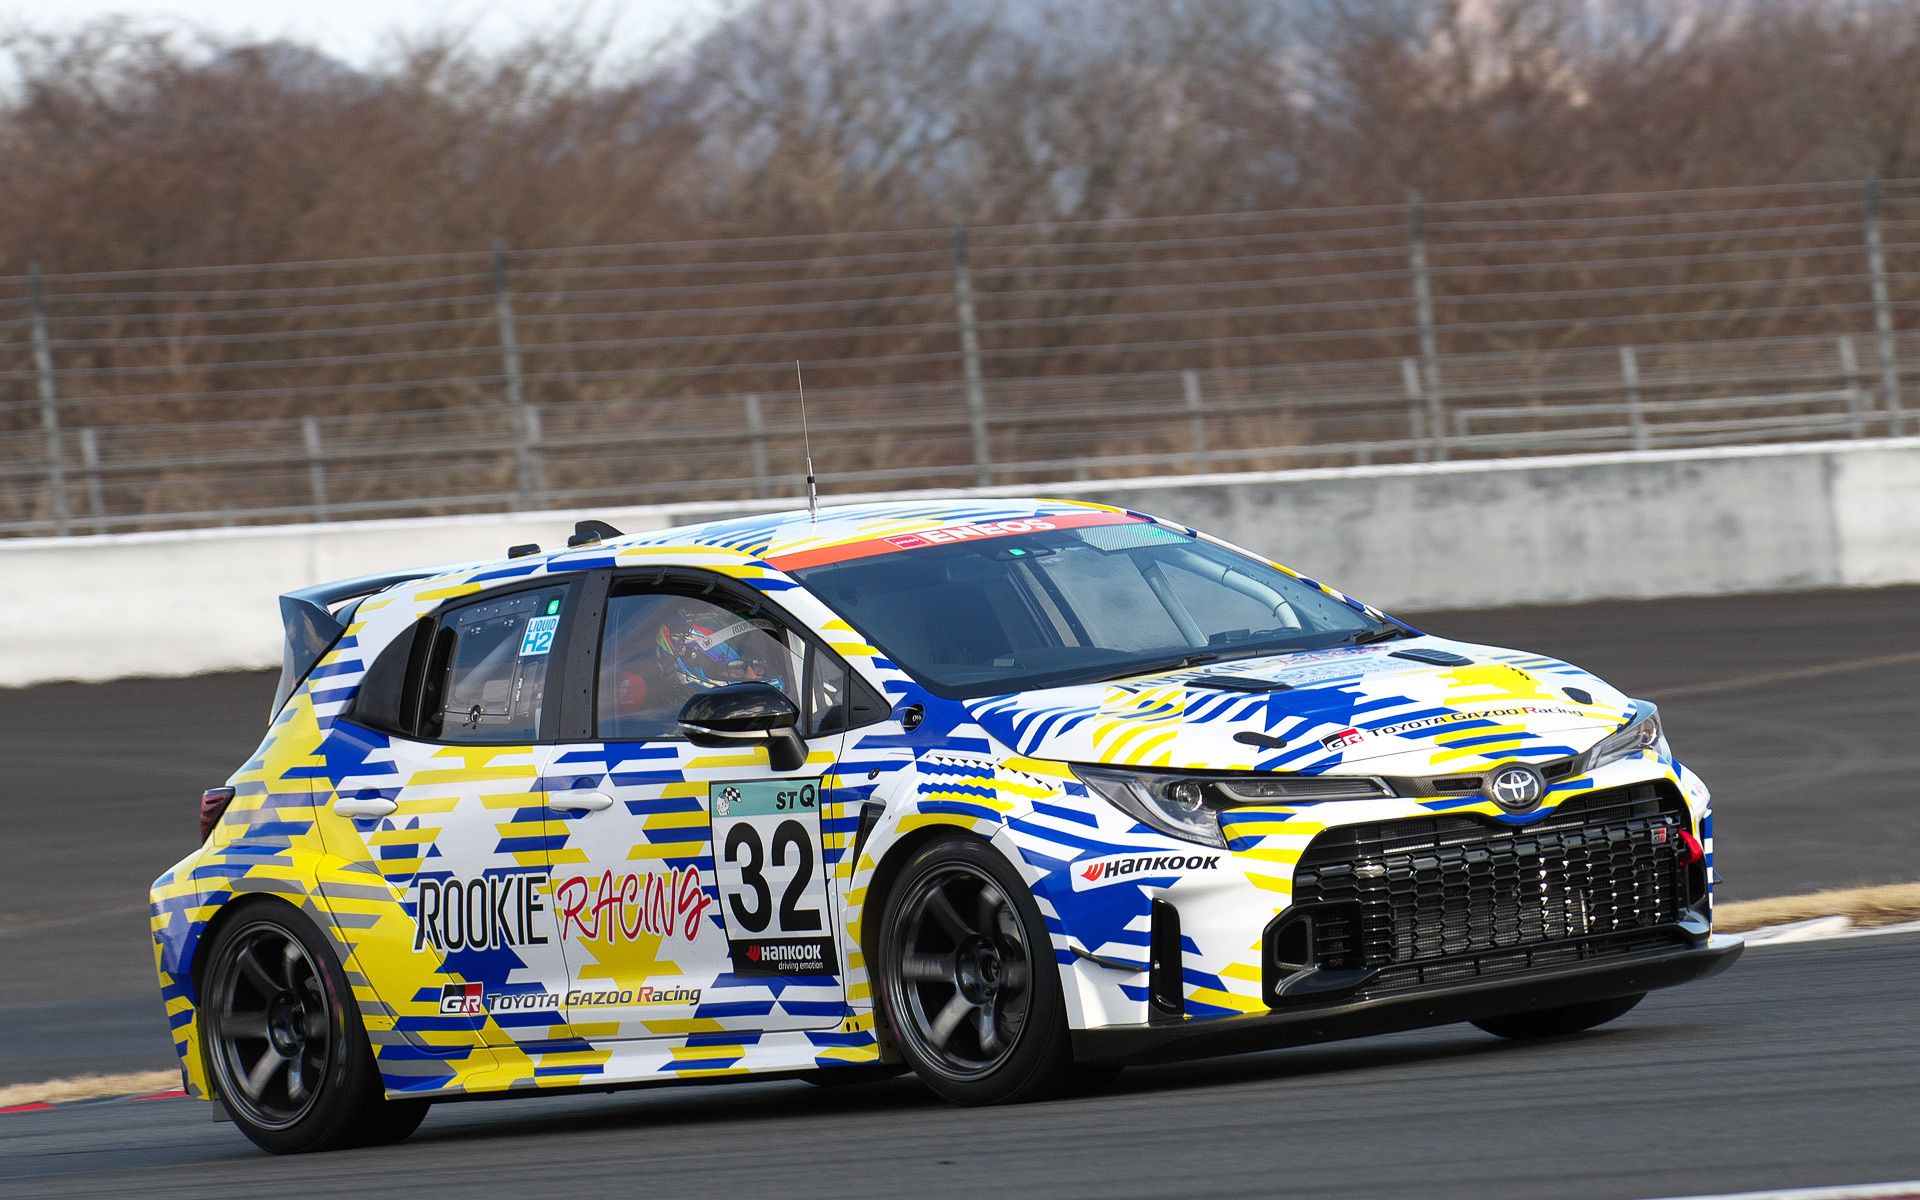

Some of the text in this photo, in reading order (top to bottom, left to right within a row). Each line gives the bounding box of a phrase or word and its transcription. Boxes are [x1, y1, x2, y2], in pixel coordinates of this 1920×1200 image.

[917, 519, 1056, 543] ENEOS
[528, 619, 557, 633] LIQUID
[521, 631, 552, 653] H2
[1325, 706, 1584, 752] GR TOYOTA GAZOO Racing
[724, 819, 822, 933] 32
[413, 866, 711, 951] ROOKIE RACING
[778, 961, 824, 972] driving emotion
[441, 985, 702, 1014] GR TOYOTA GAZOO Racing
